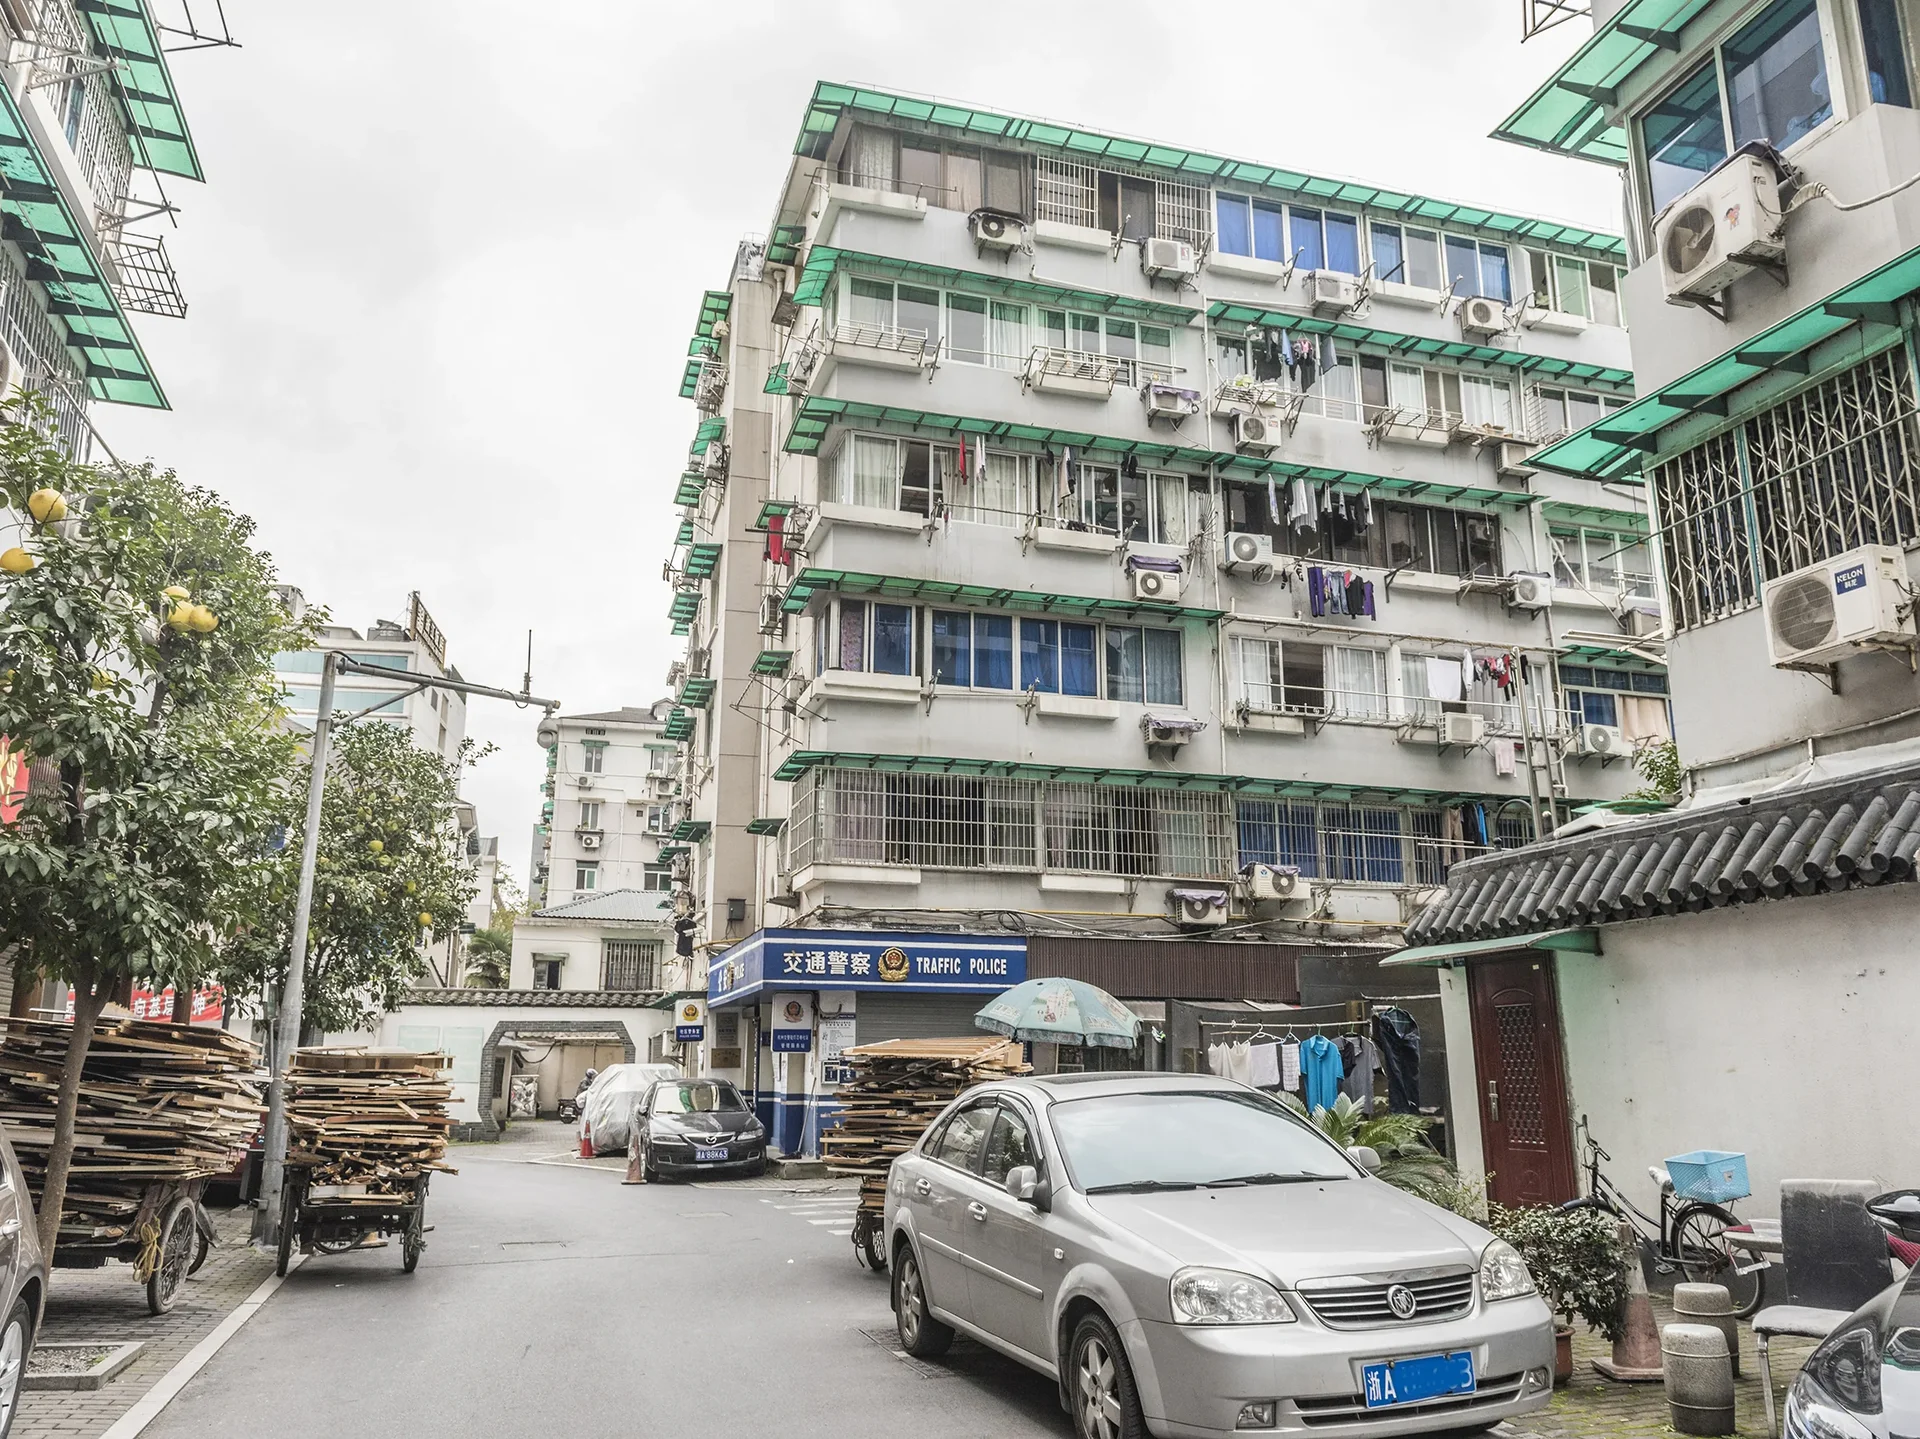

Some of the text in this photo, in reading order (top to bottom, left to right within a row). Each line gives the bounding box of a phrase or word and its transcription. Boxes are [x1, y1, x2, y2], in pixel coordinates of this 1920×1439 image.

[1837, 568, 1863, 583] KELON
[783, 950, 871, 975] 交通警察
[916, 957, 1008, 975] TRAFFIC POLICE
